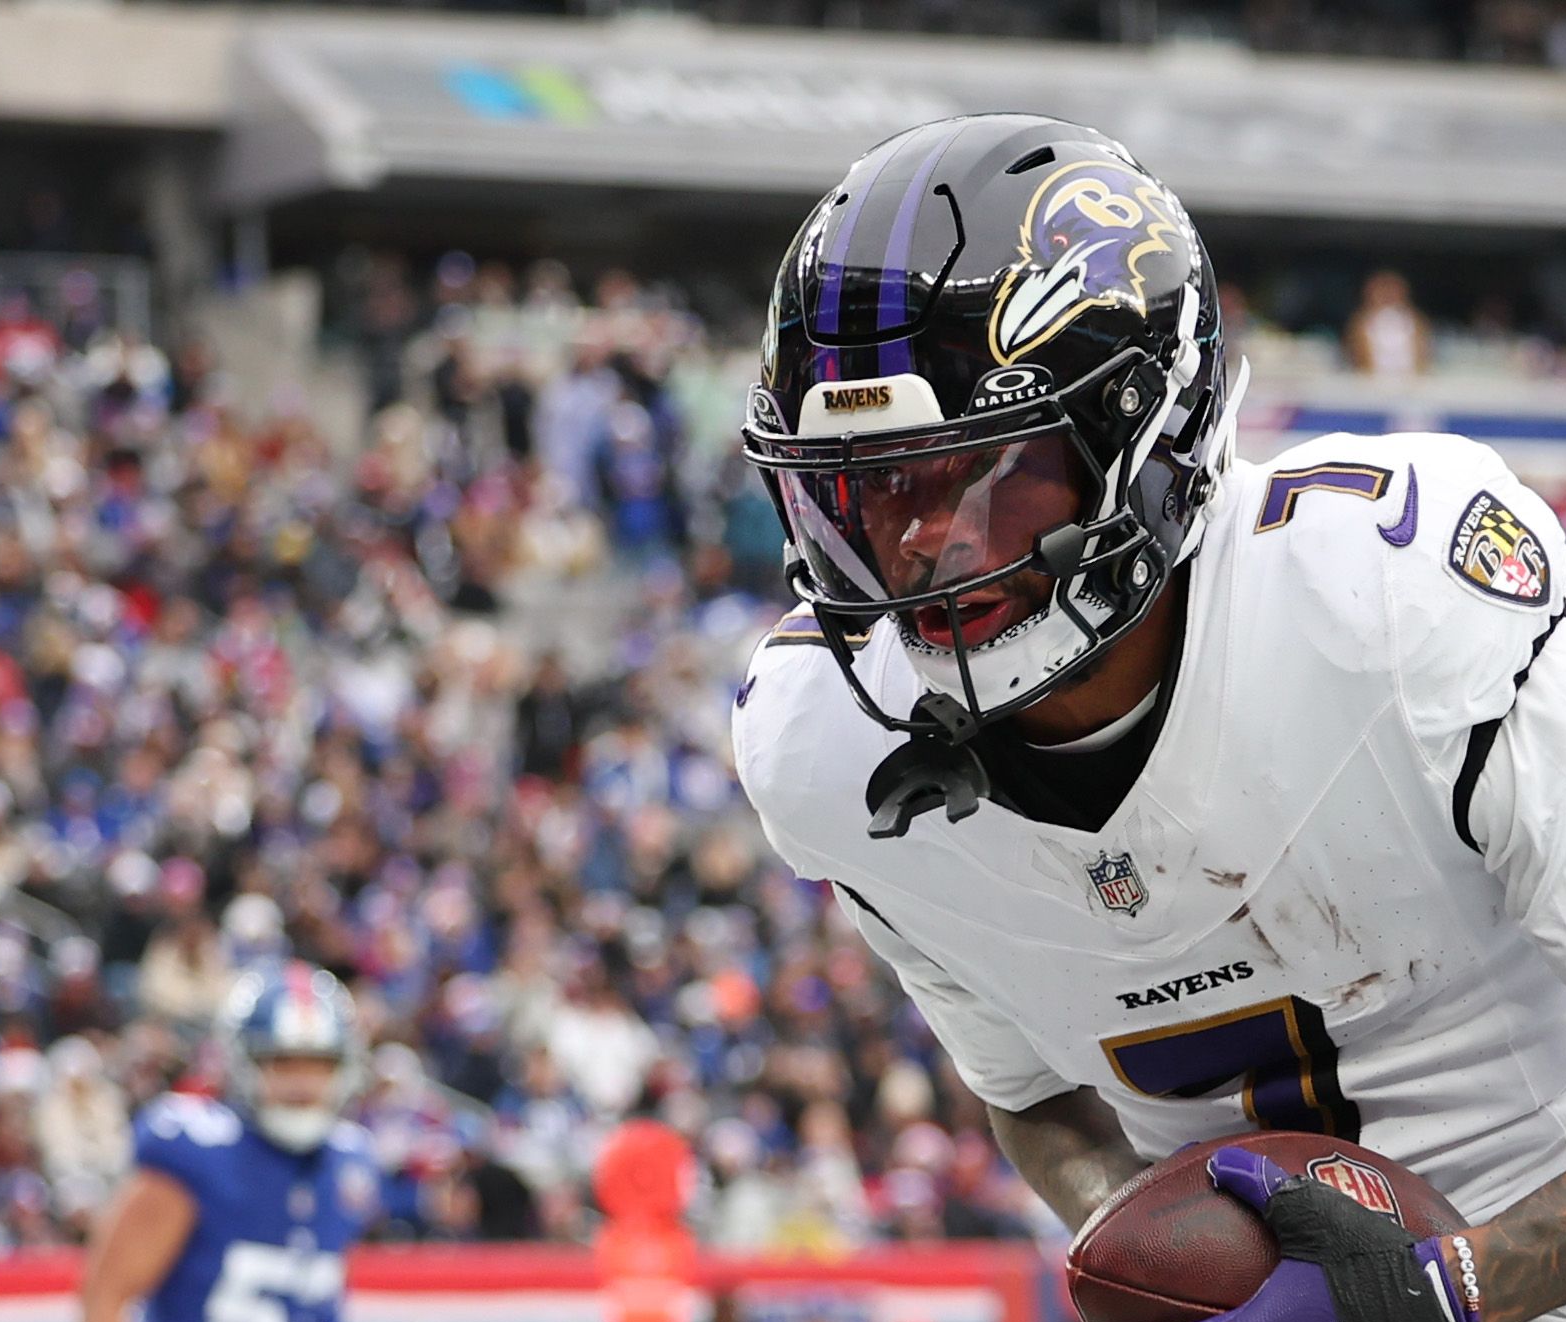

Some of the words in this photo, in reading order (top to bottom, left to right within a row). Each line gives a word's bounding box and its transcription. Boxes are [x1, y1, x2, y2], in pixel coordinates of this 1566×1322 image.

[822, 385, 891, 412] RAVENS
[974, 384, 1051, 408] OAKLEY
[1453, 495, 1492, 566] RAVENS
[1101, 878, 1140, 905] NFL
[1115, 960, 1255, 1009] RAVENS
[1098, 994, 1361, 1146] 7
[1318, 1162, 1395, 1211] NFL
